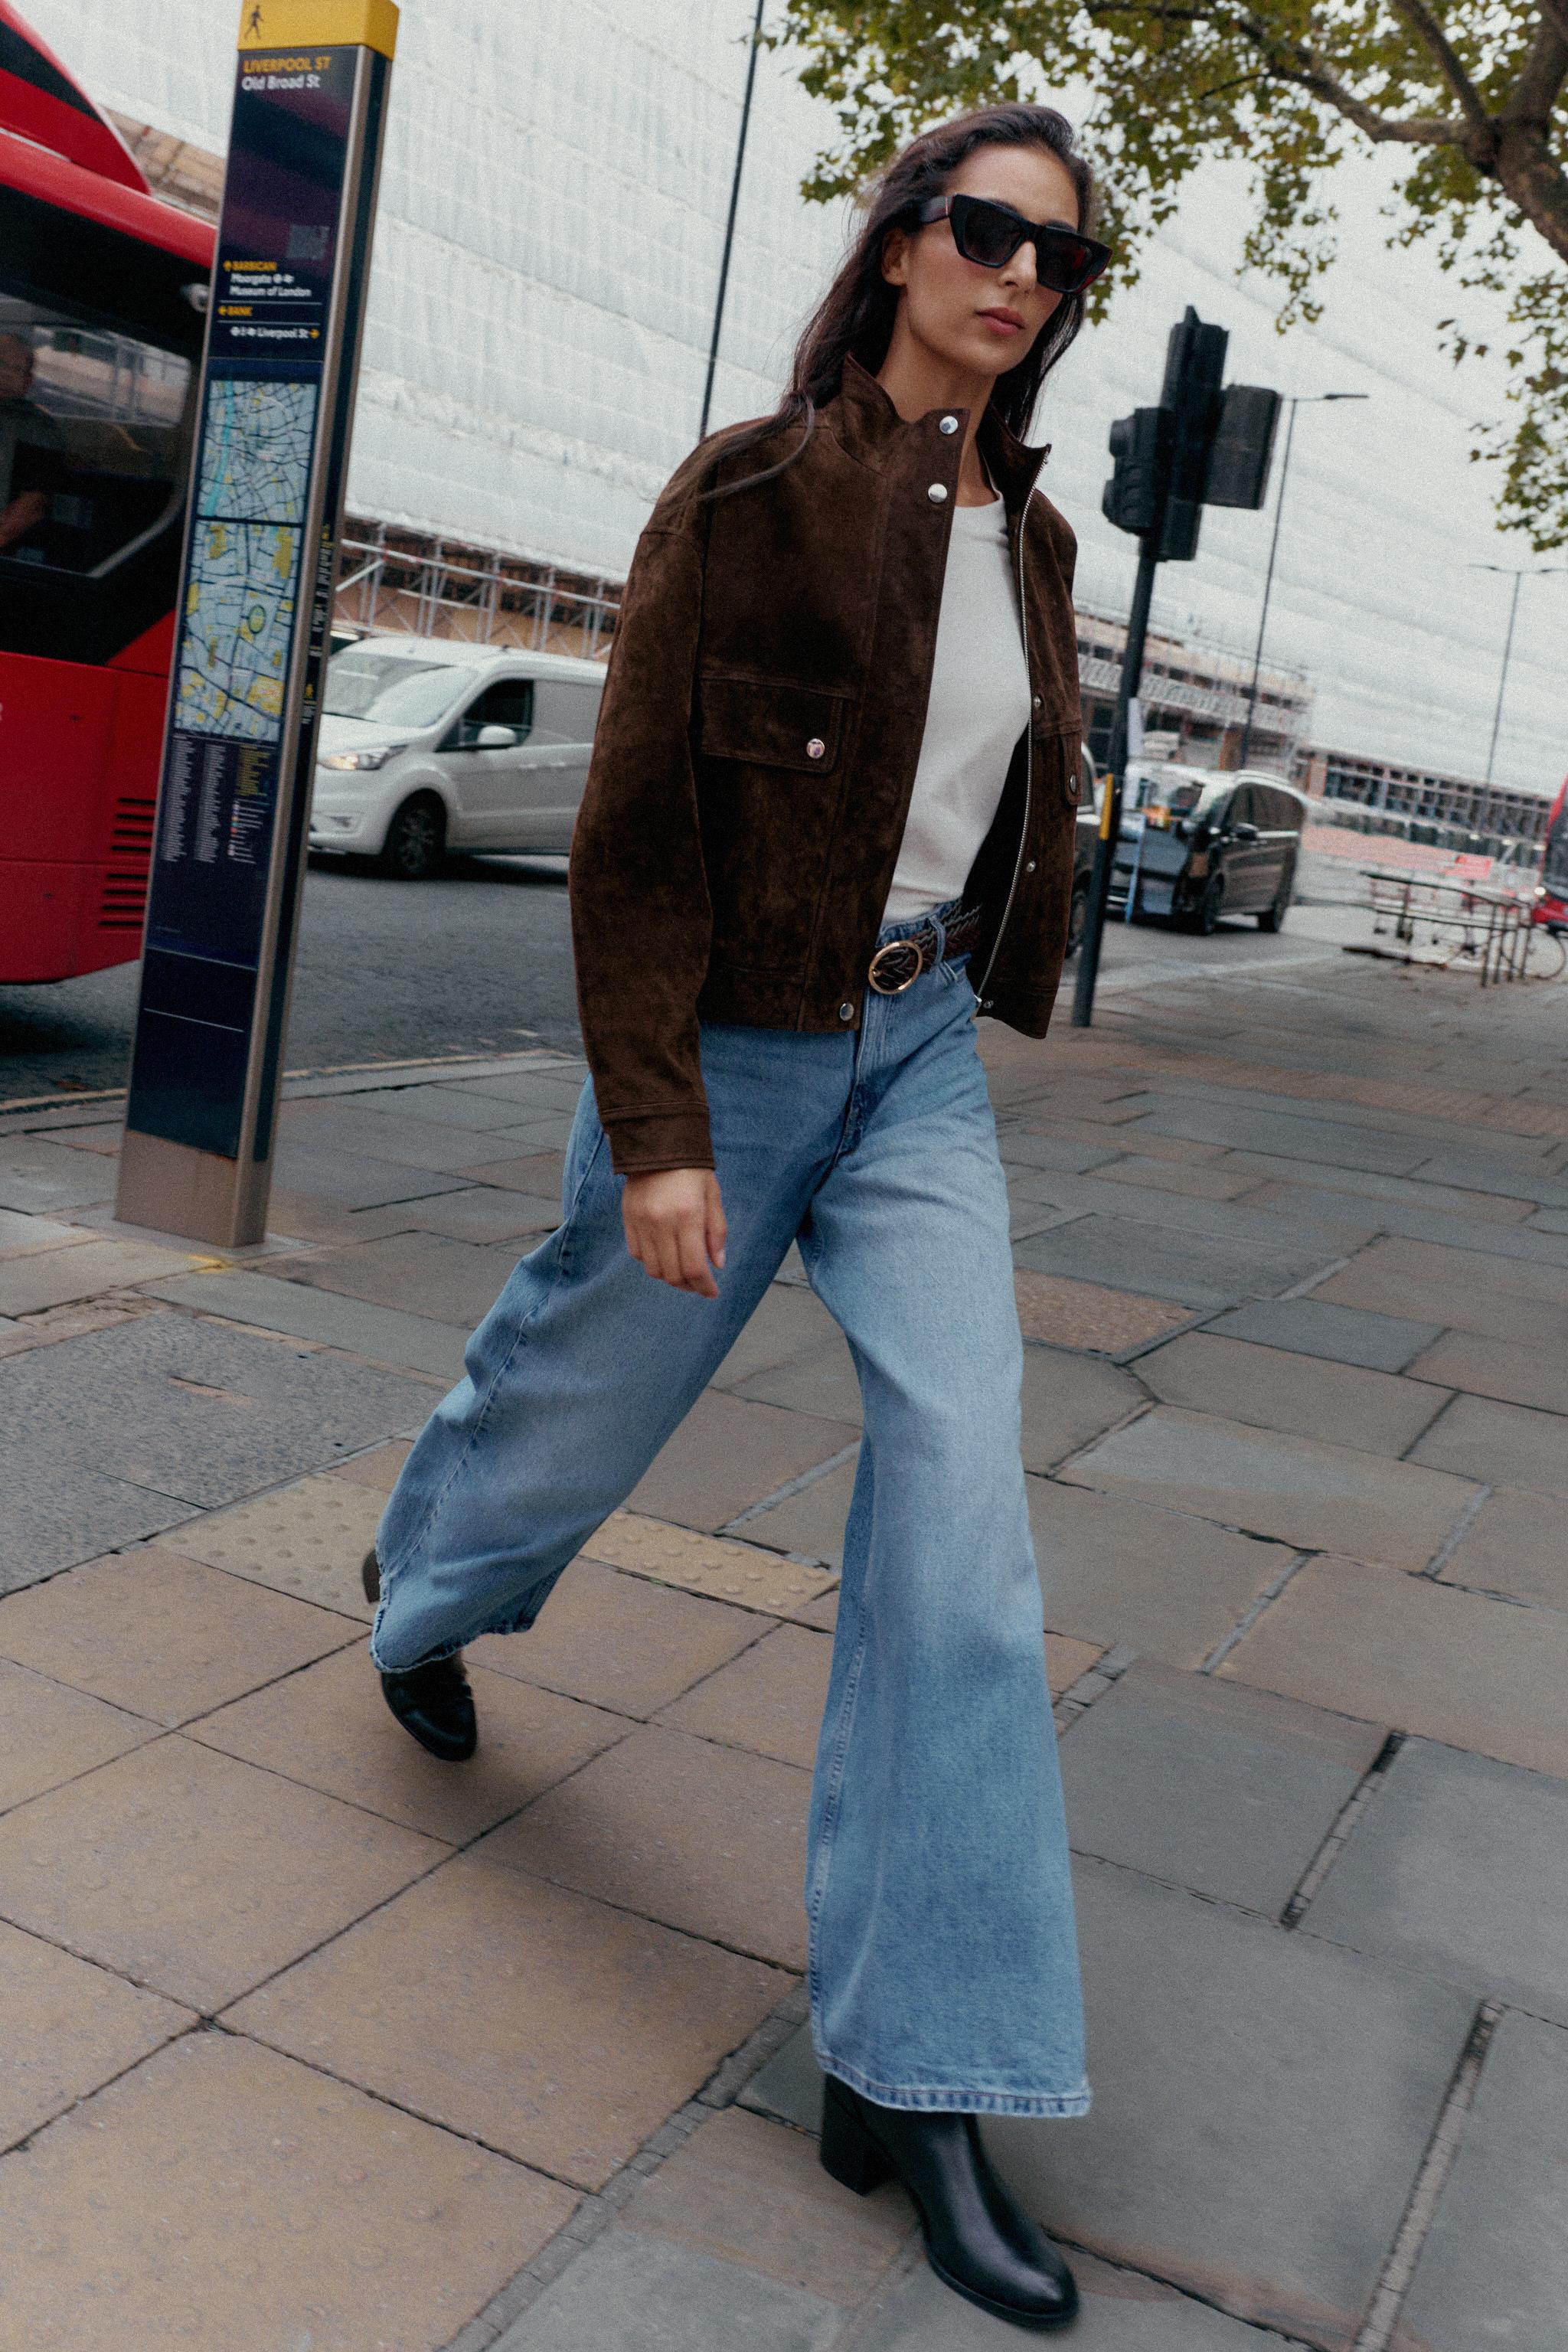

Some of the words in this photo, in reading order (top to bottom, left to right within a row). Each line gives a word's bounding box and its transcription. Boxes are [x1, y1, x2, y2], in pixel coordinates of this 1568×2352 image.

[242, 57, 312, 74] LIVERPOOL
[315, 56, 332, 70] ST
[241, 76, 266, 90] Old
[267, 75, 305, 90] Broad
[306, 74, 320, 88] St
[278, 287, 312, 296] London
[256, 327, 296, 339] Liverpool
